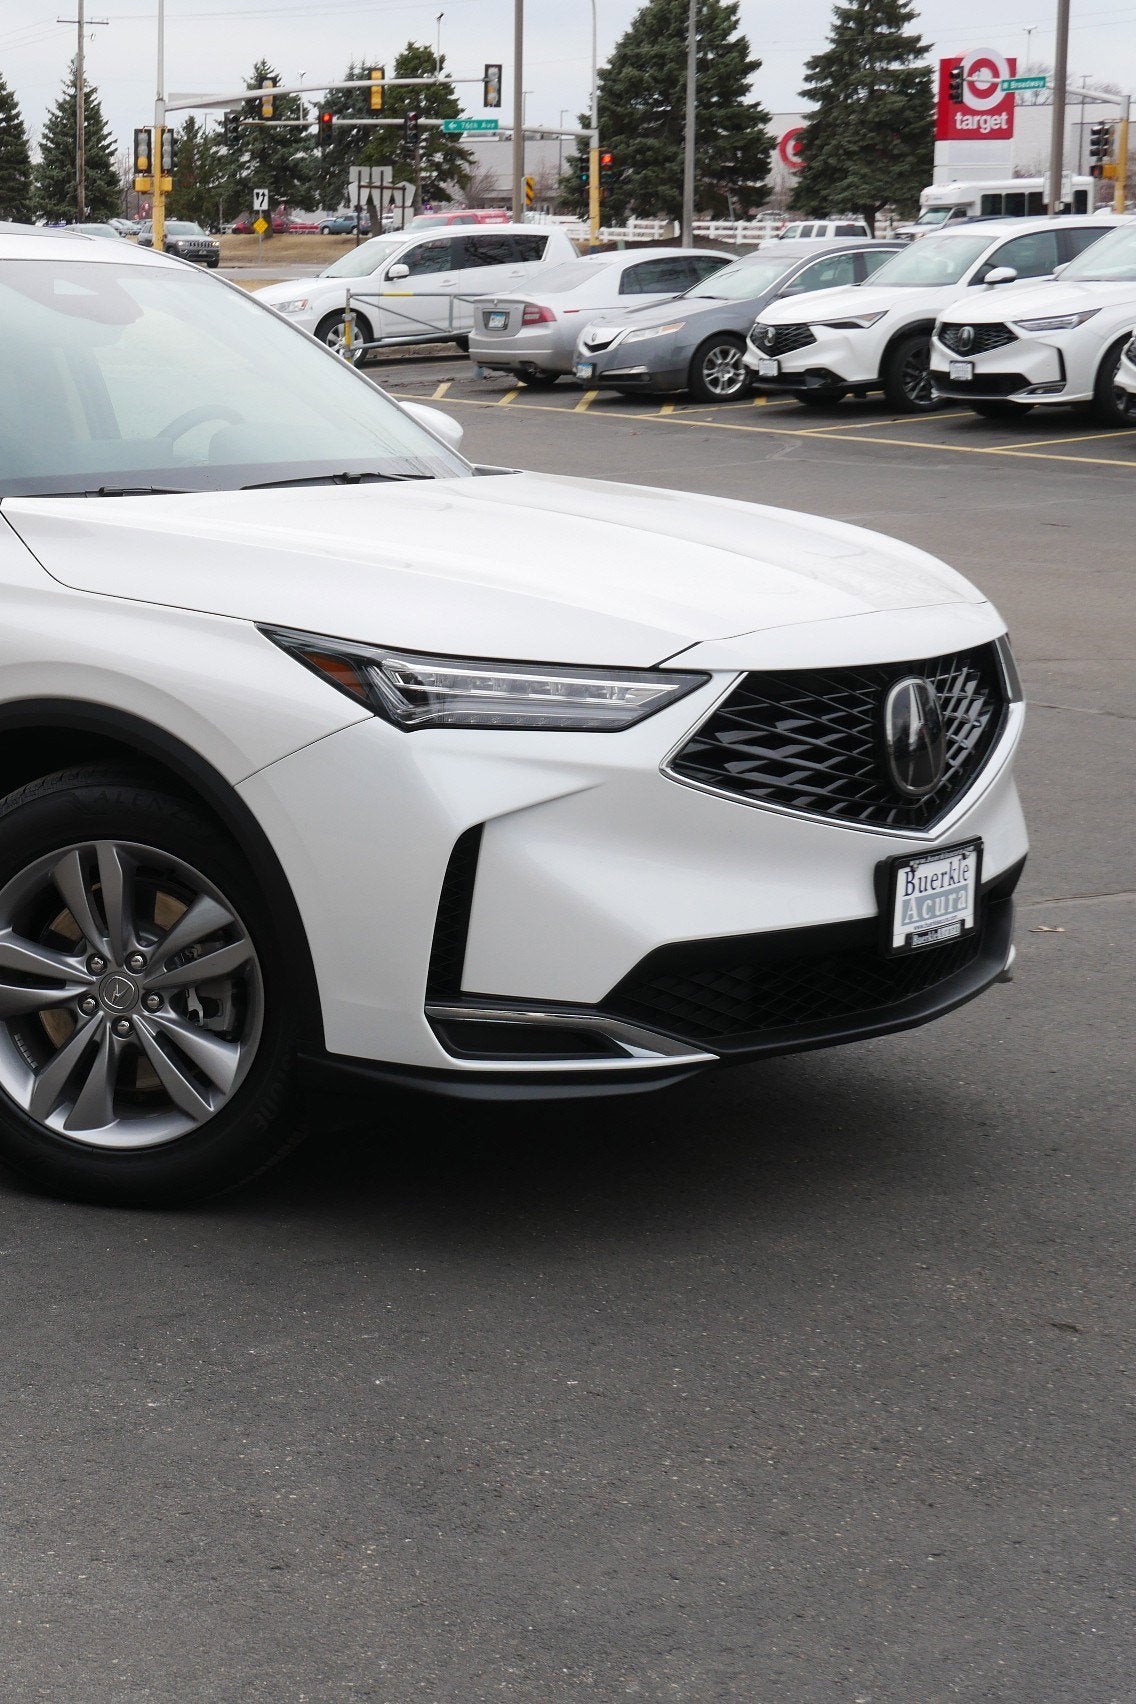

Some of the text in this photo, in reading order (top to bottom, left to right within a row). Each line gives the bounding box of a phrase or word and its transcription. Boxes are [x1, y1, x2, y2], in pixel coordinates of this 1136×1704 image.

[1010, 80, 1044, 89] Broadway
[481, 121, 496, 129] Ave
[955, 112, 1009, 133] target
[904, 859, 969, 897] Buerkle
[905, 890, 967, 923] Acura
